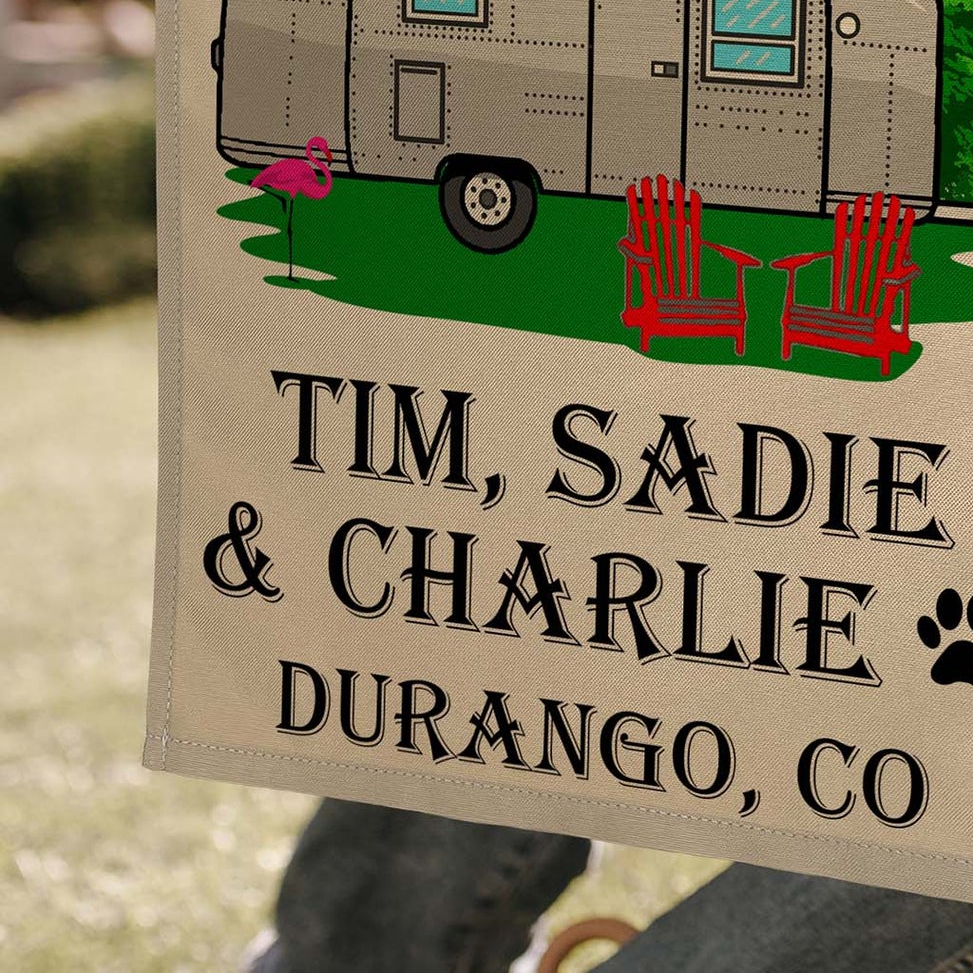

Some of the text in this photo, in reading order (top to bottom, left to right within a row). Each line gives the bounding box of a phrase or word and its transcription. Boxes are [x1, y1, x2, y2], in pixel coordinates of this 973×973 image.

[271, 370, 956, 550] TIM, SADIE
[203, 501, 883, 688] & CHARLIE
[276, 660, 930, 829] DURANGO, CO
